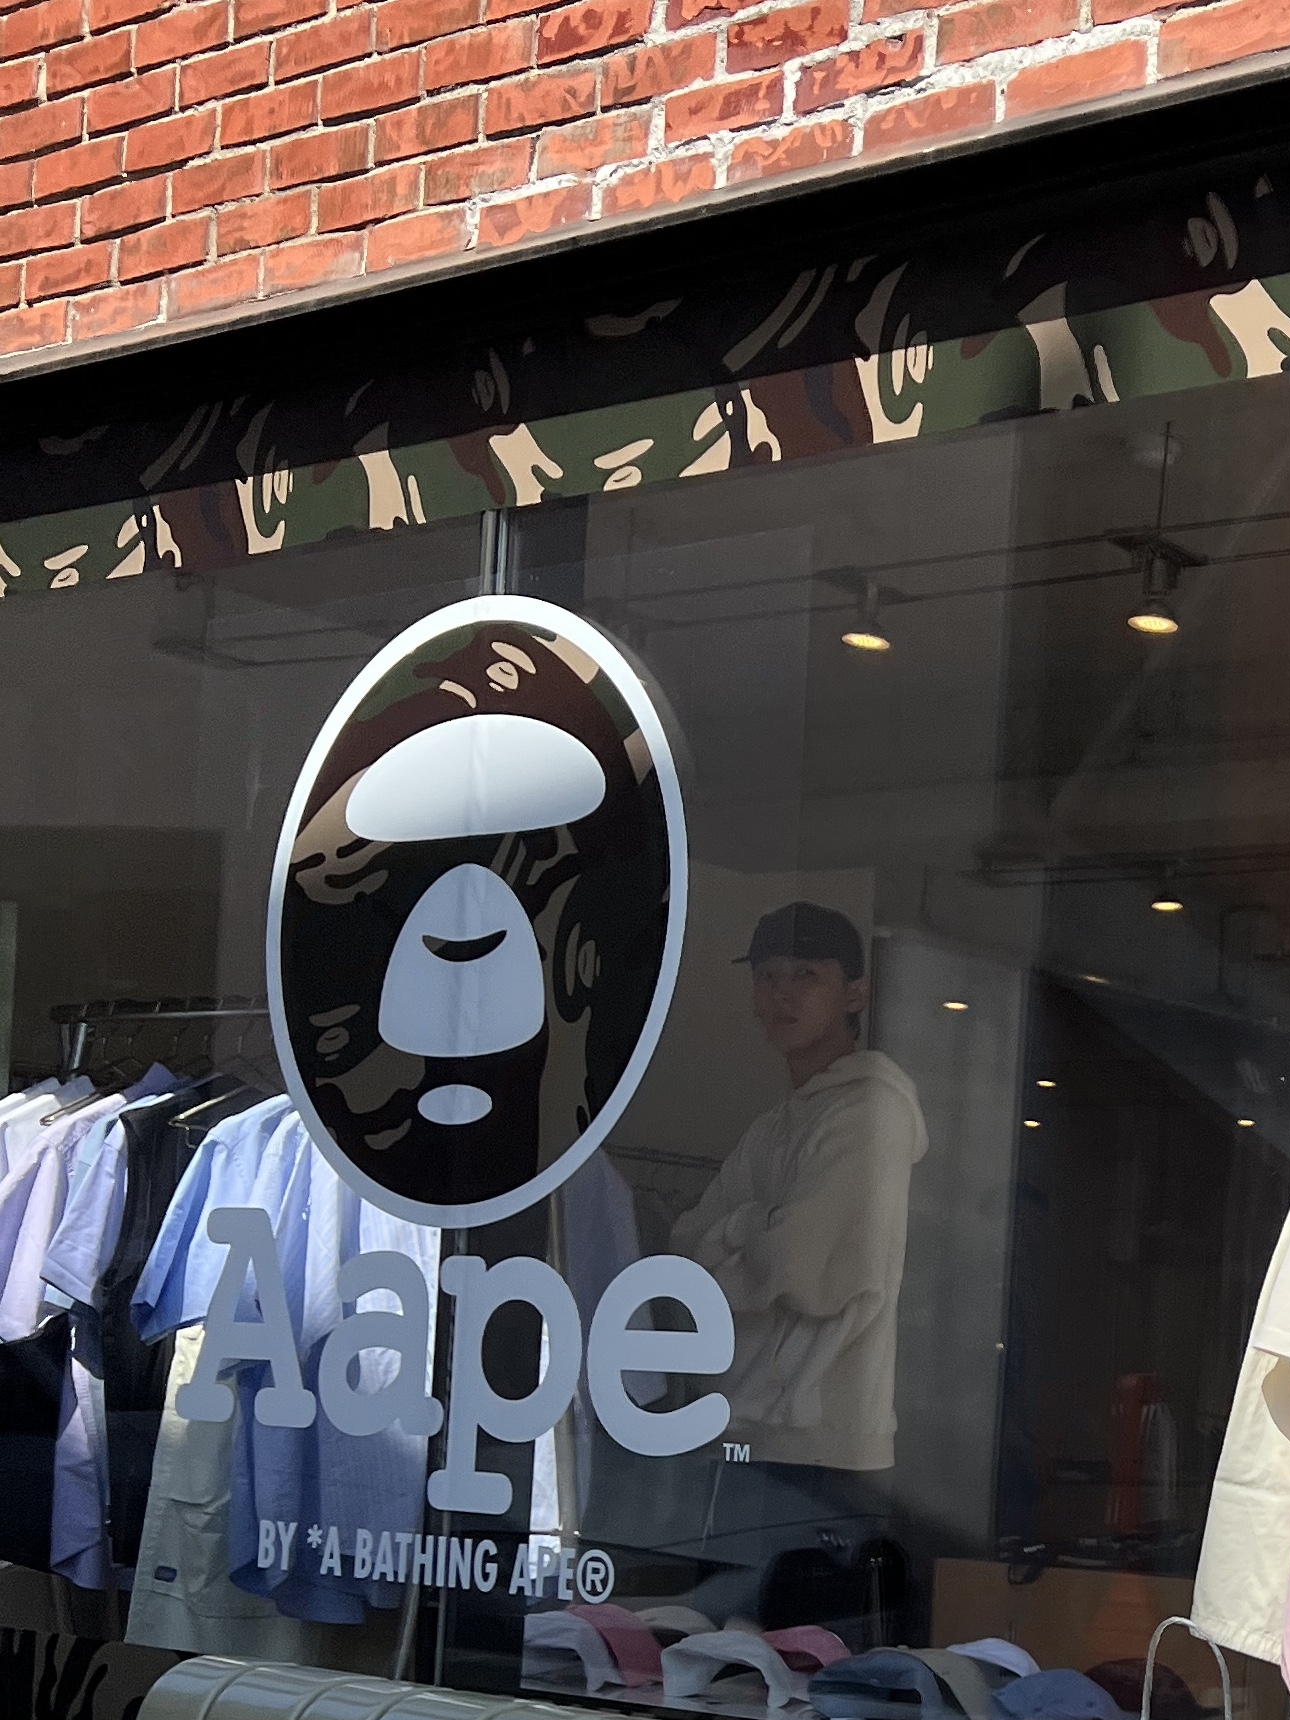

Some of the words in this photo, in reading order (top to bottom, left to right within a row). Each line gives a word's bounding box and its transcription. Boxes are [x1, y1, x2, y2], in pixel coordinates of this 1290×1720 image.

[174, 1206, 736, 1516] Aape
[722, 1442, 751, 1463] TM
[257, 1519, 298, 1571] BY
[353, 1532, 498, 1592] BATHING
